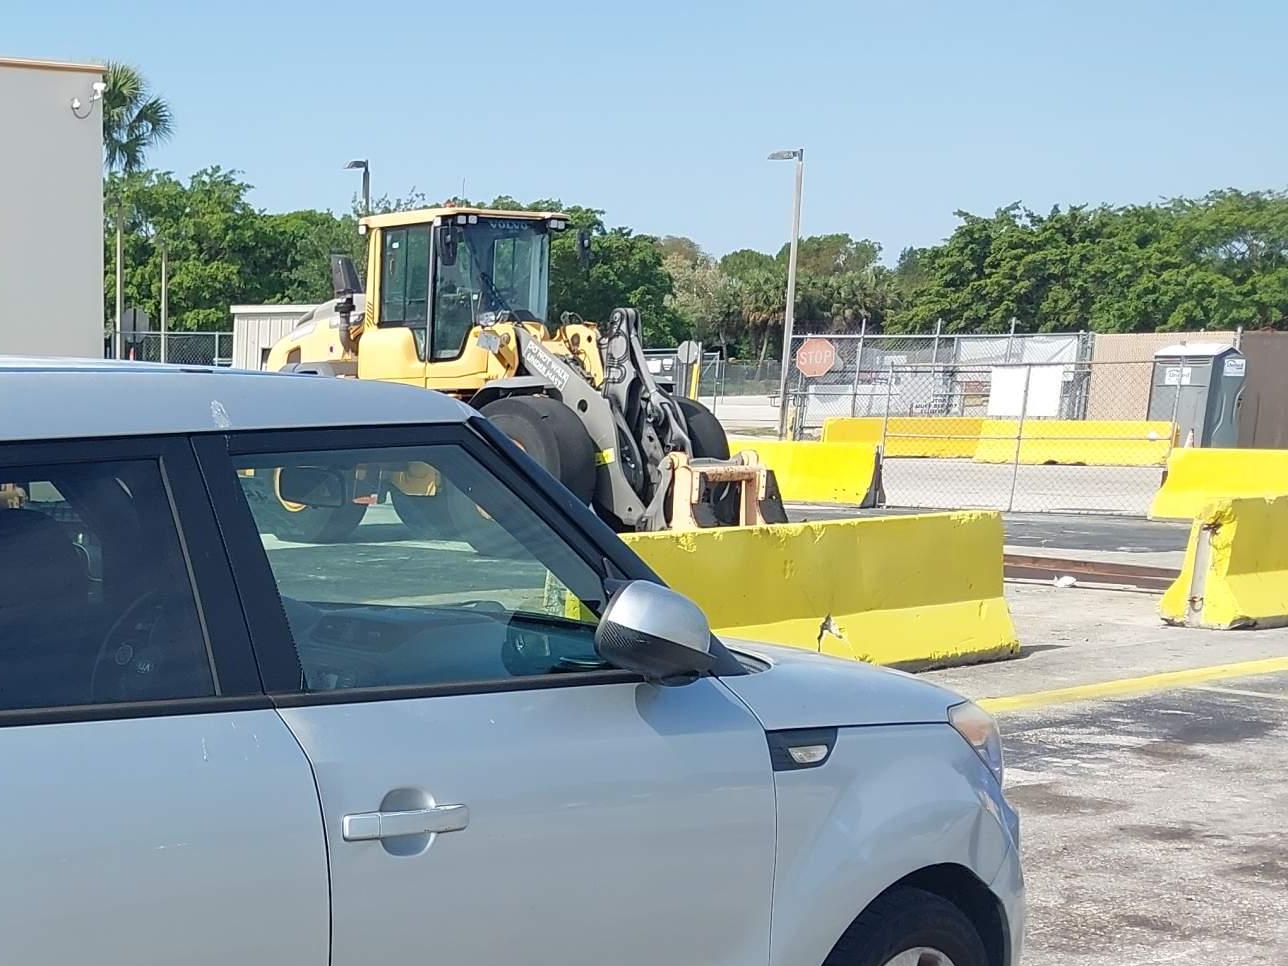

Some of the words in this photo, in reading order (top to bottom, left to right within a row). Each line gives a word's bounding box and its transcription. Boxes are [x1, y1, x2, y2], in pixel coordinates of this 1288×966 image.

[489, 219, 528, 231] VOLVO
[527, 342, 538, 354] DO
[537, 350, 552, 365] NOT
[799, 350, 832, 366] STOP
